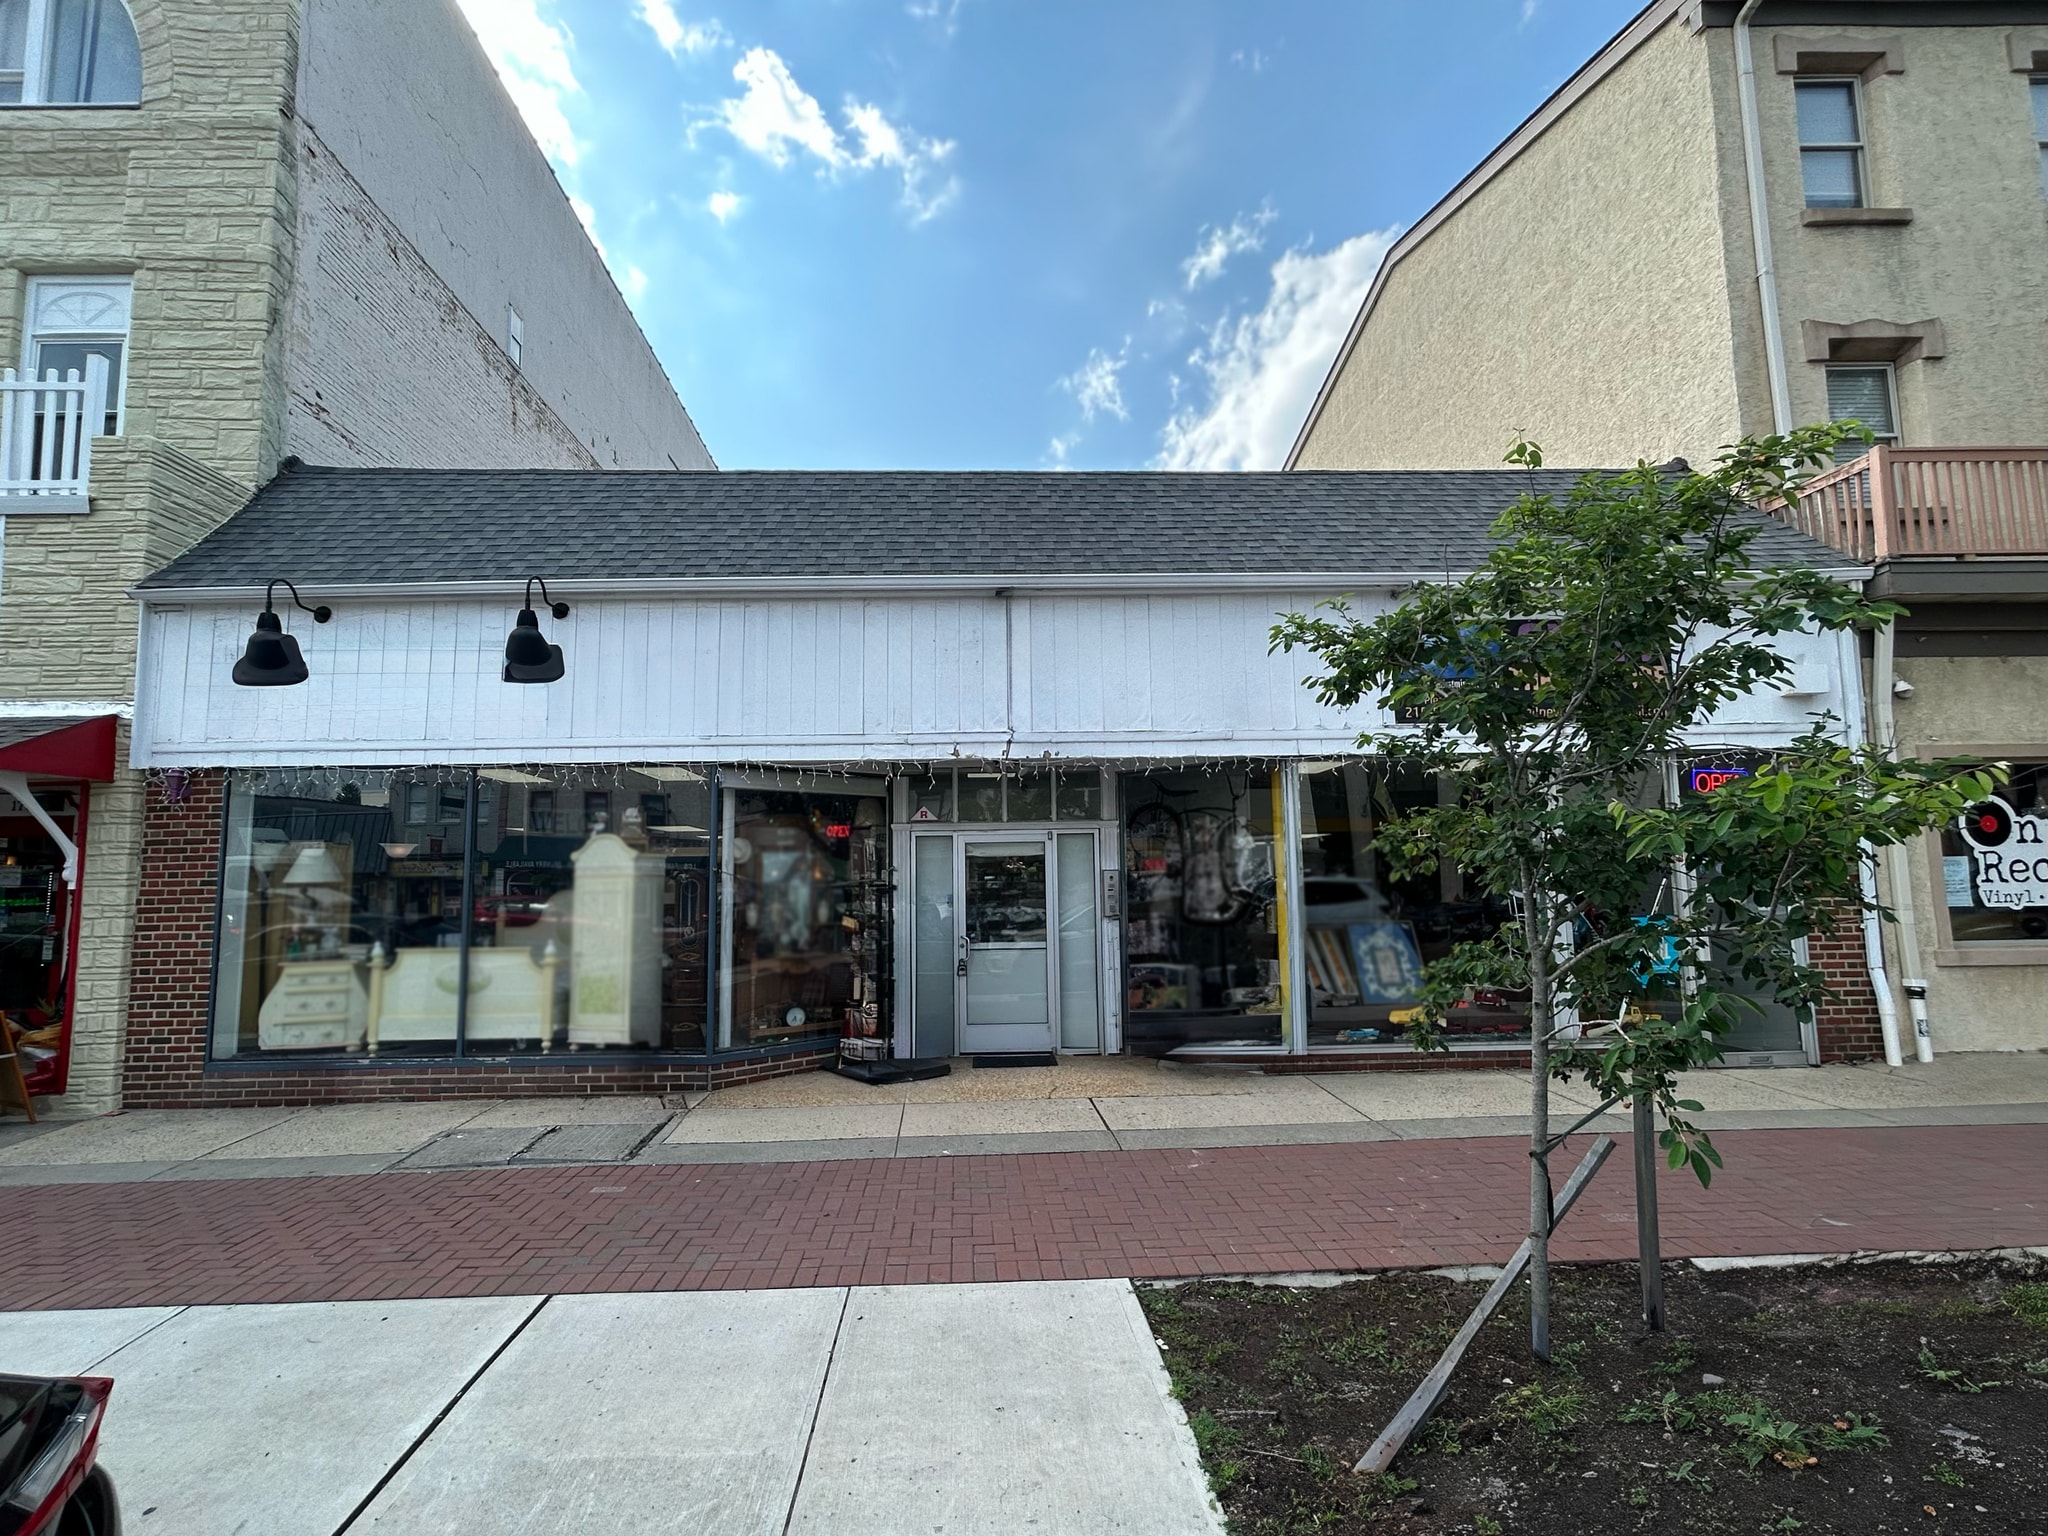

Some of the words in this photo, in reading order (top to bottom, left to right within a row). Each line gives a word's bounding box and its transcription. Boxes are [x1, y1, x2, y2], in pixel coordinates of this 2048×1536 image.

[920, 810, 928, 819] R
[826, 825, 850, 837] OPEN
[1983, 889, 2035, 907] Vinyl
